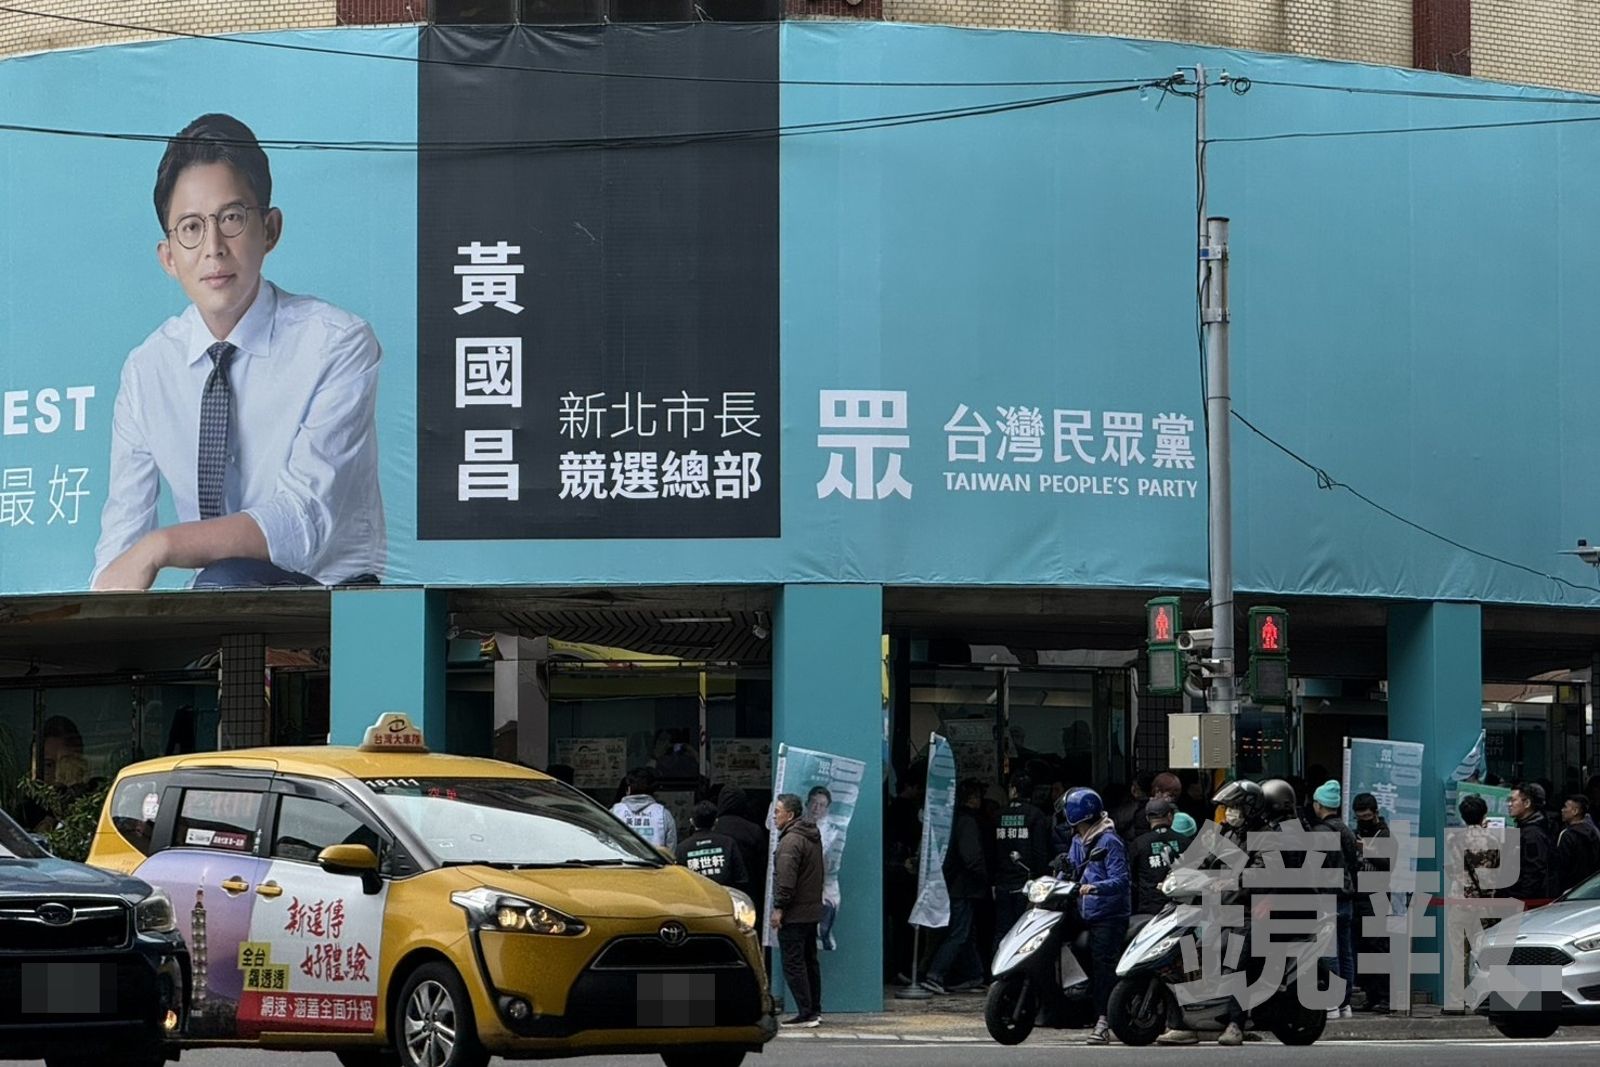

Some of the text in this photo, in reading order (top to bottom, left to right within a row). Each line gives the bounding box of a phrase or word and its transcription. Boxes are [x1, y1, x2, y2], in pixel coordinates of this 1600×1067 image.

[453, 240, 525, 501] 黃國昌
[3, 385, 96, 436] EST
[558, 389, 762, 439] 新北市長
[815, 389, 913, 500] 眾
[942, 402, 1196, 470] 台灣民眾黨
[0, 464, 91, 527] 最好
[558, 450, 763, 500] 競選總部
[943, 472, 1198, 499] TAIWAN PEOPLE'S PARTY
[374, 733, 421, 745] 台灣大車隊
[284, 896, 345, 939] 新遠傳
[242, 947, 266, 967] 全台
[300, 942, 372, 982] 好體驗
